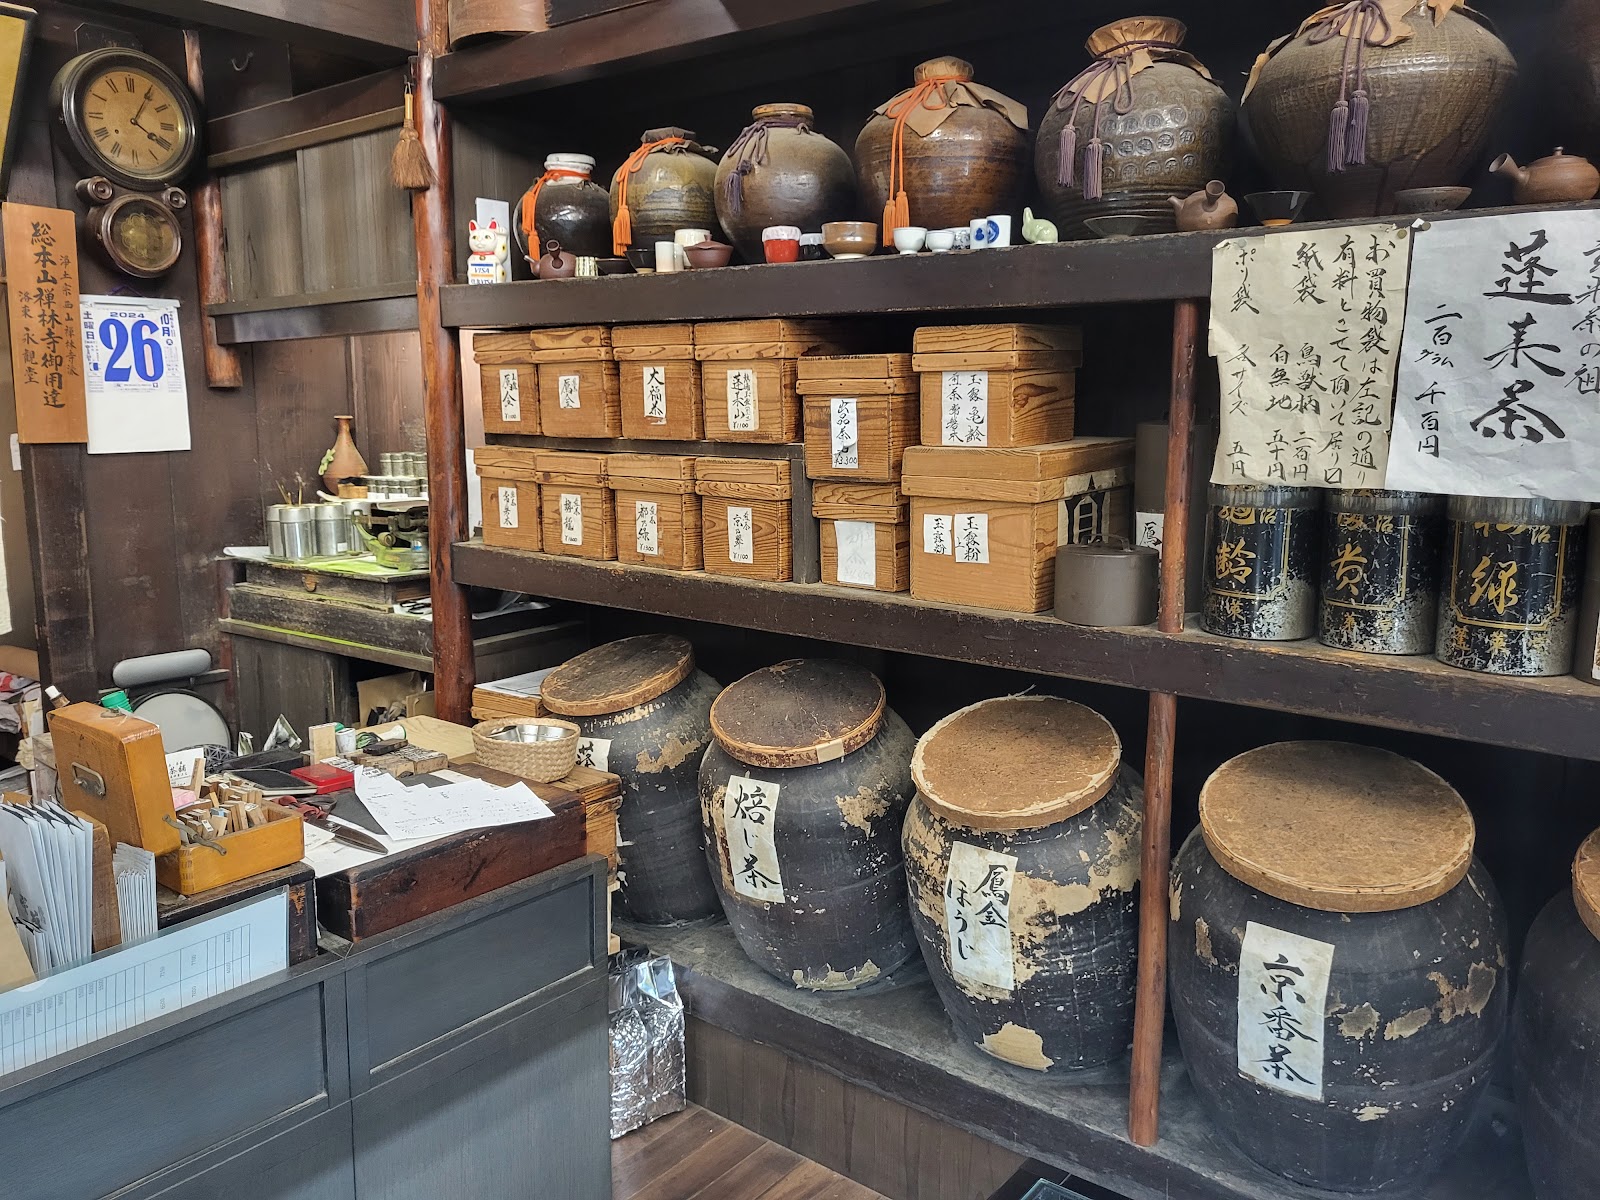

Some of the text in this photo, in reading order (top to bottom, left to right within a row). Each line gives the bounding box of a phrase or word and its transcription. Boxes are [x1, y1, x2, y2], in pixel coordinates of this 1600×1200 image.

[1293, 242, 1328, 305] 紙袋
[30, 222, 66, 409] 総本山禅林寺御用達
[83, 310, 94, 340] 土曜日
[98, 318, 164, 382] 26
[160, 314, 170, 337] 10月
[1225, 248, 1260, 479] ポリ袋 各サイズ 五円
[1290, 342, 1328, 416] 鳥獣柄
[1350, 234, 1396, 488] お買物袋は左記の通り
[1414, 304, 1463, 458] 二百グラム 千百円
[1266, 428, 1290, 482] 五十円
[730, 784, 781, 888] 焙じ茶
[946, 878, 974, 960] ほうじ
[1257, 954, 1318, 1086] 京番茶
